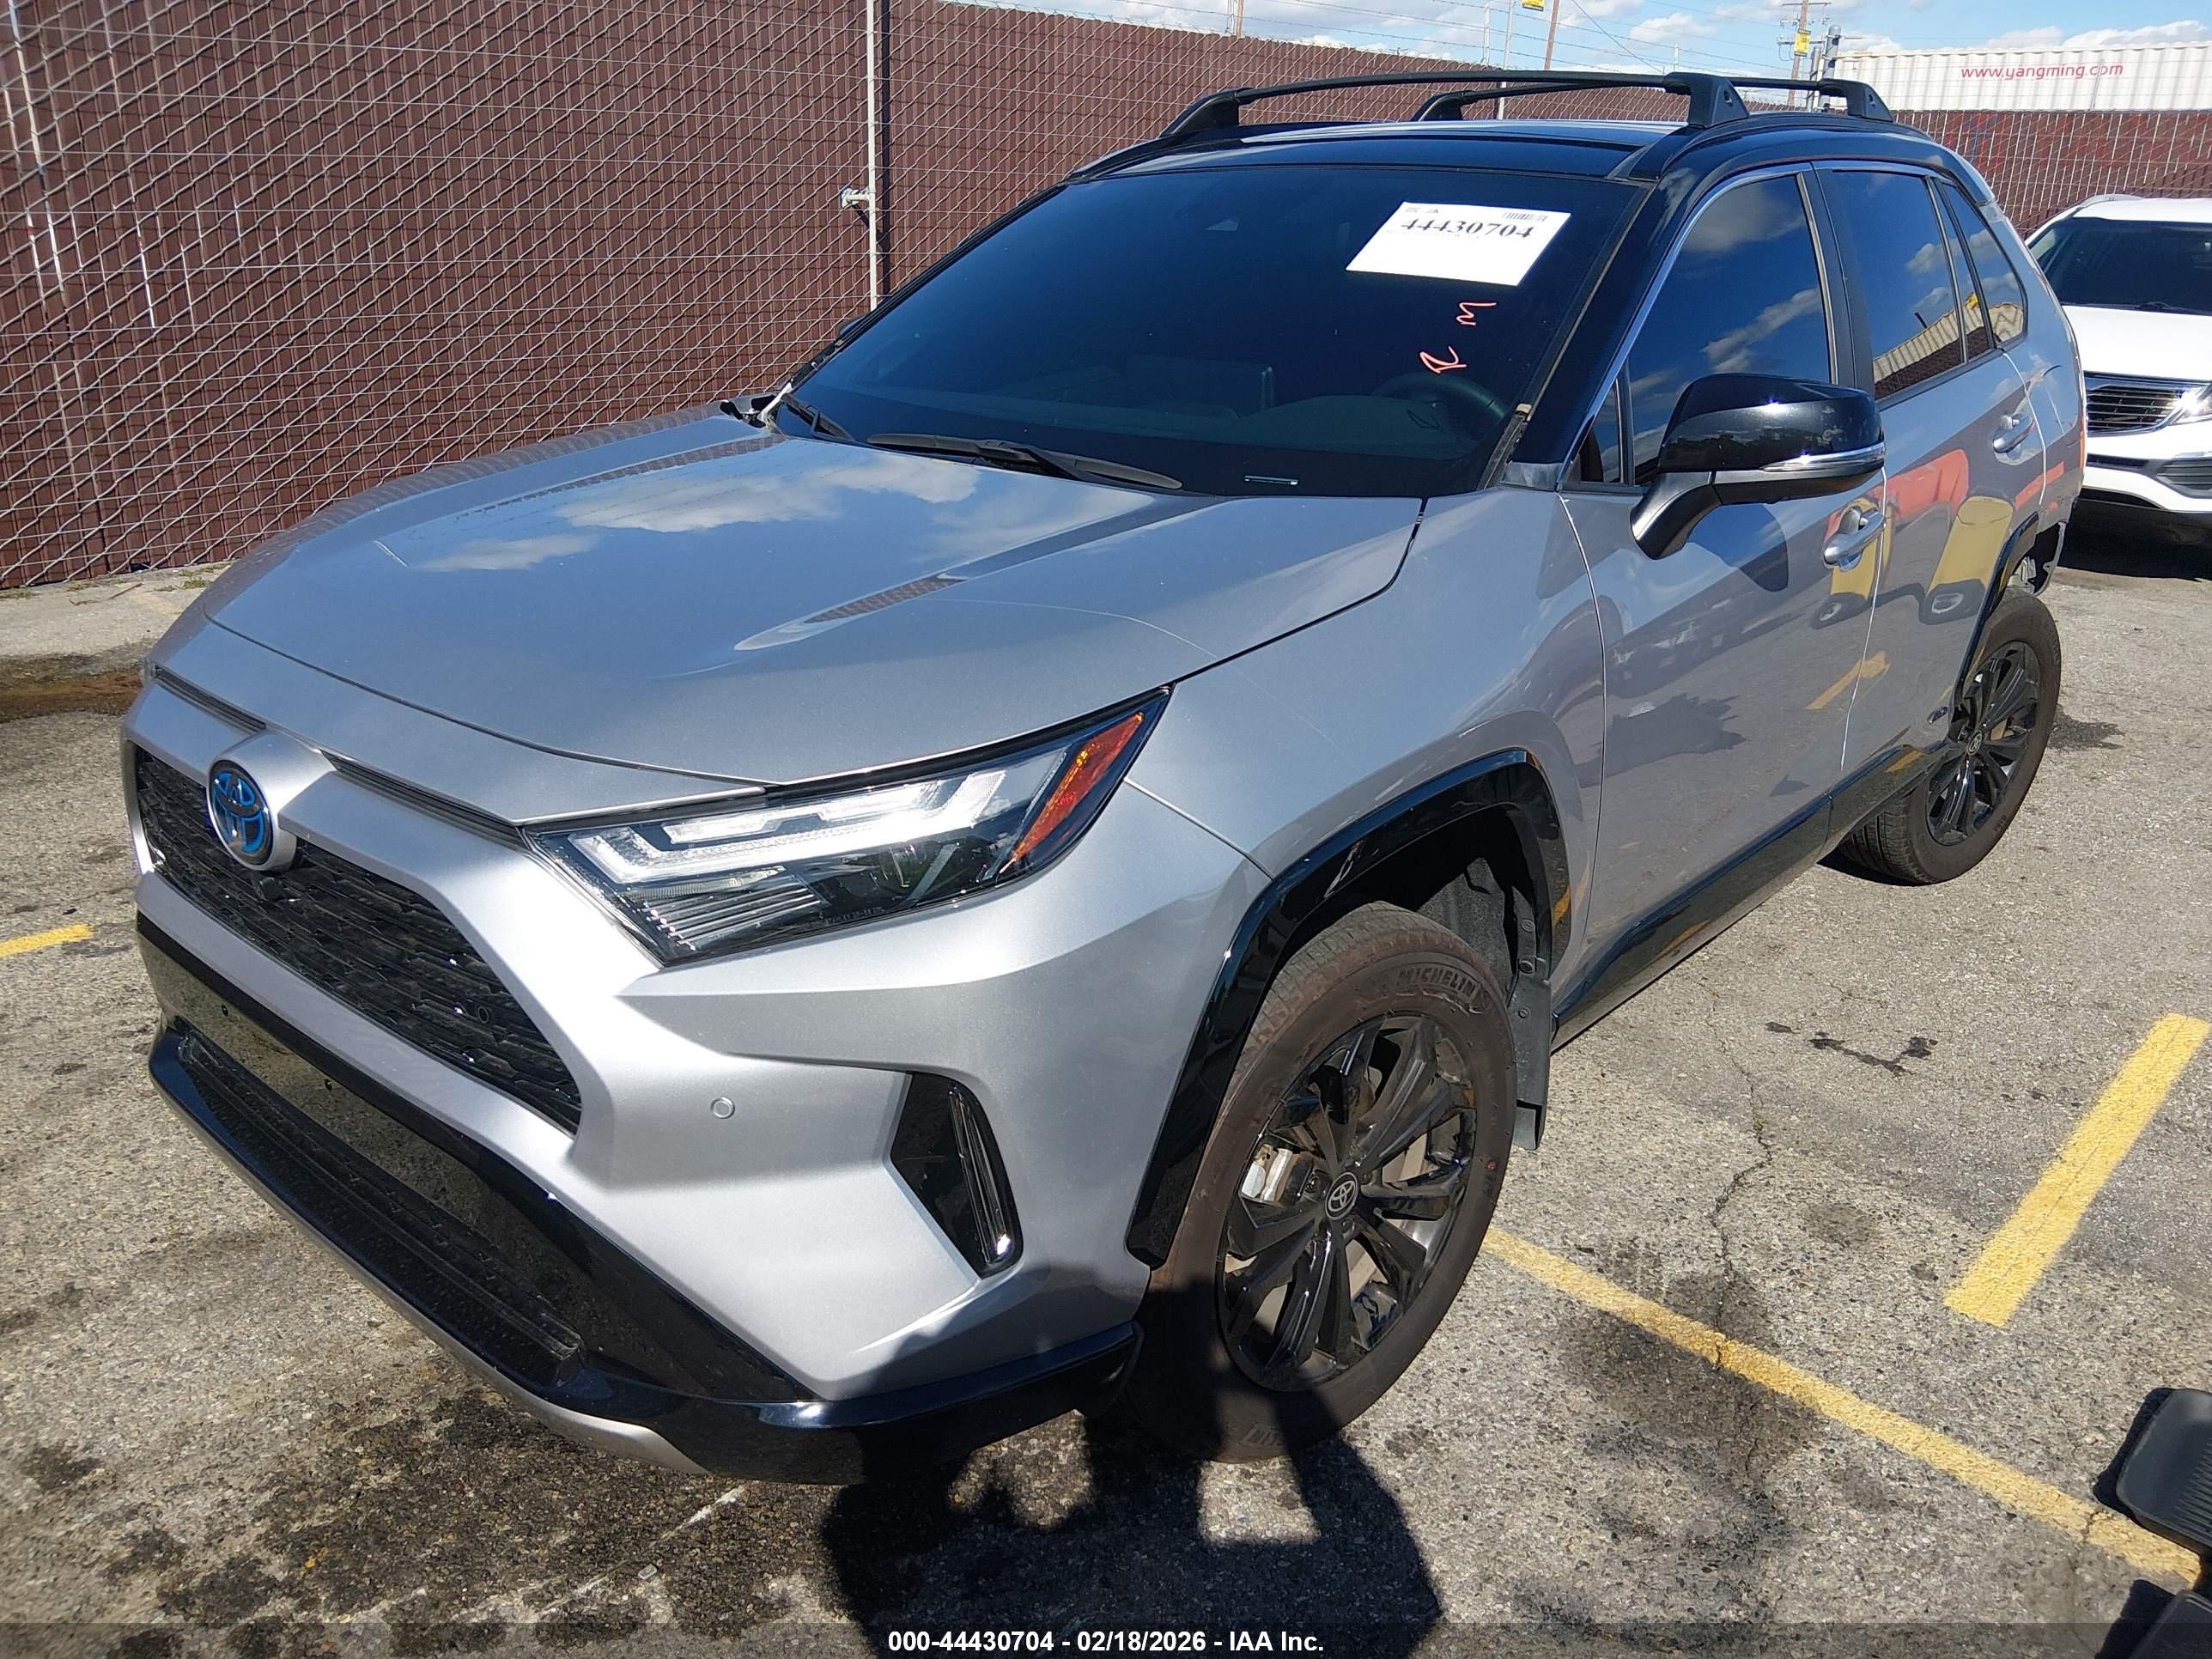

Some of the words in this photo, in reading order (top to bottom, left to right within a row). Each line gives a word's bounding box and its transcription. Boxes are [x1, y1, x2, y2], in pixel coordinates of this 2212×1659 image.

[1961, 64, 2124, 80] www.yangming.com
[1401, 218, 1534, 238] 44430704
[1396, 967, 1477, 998] MICHELIN
